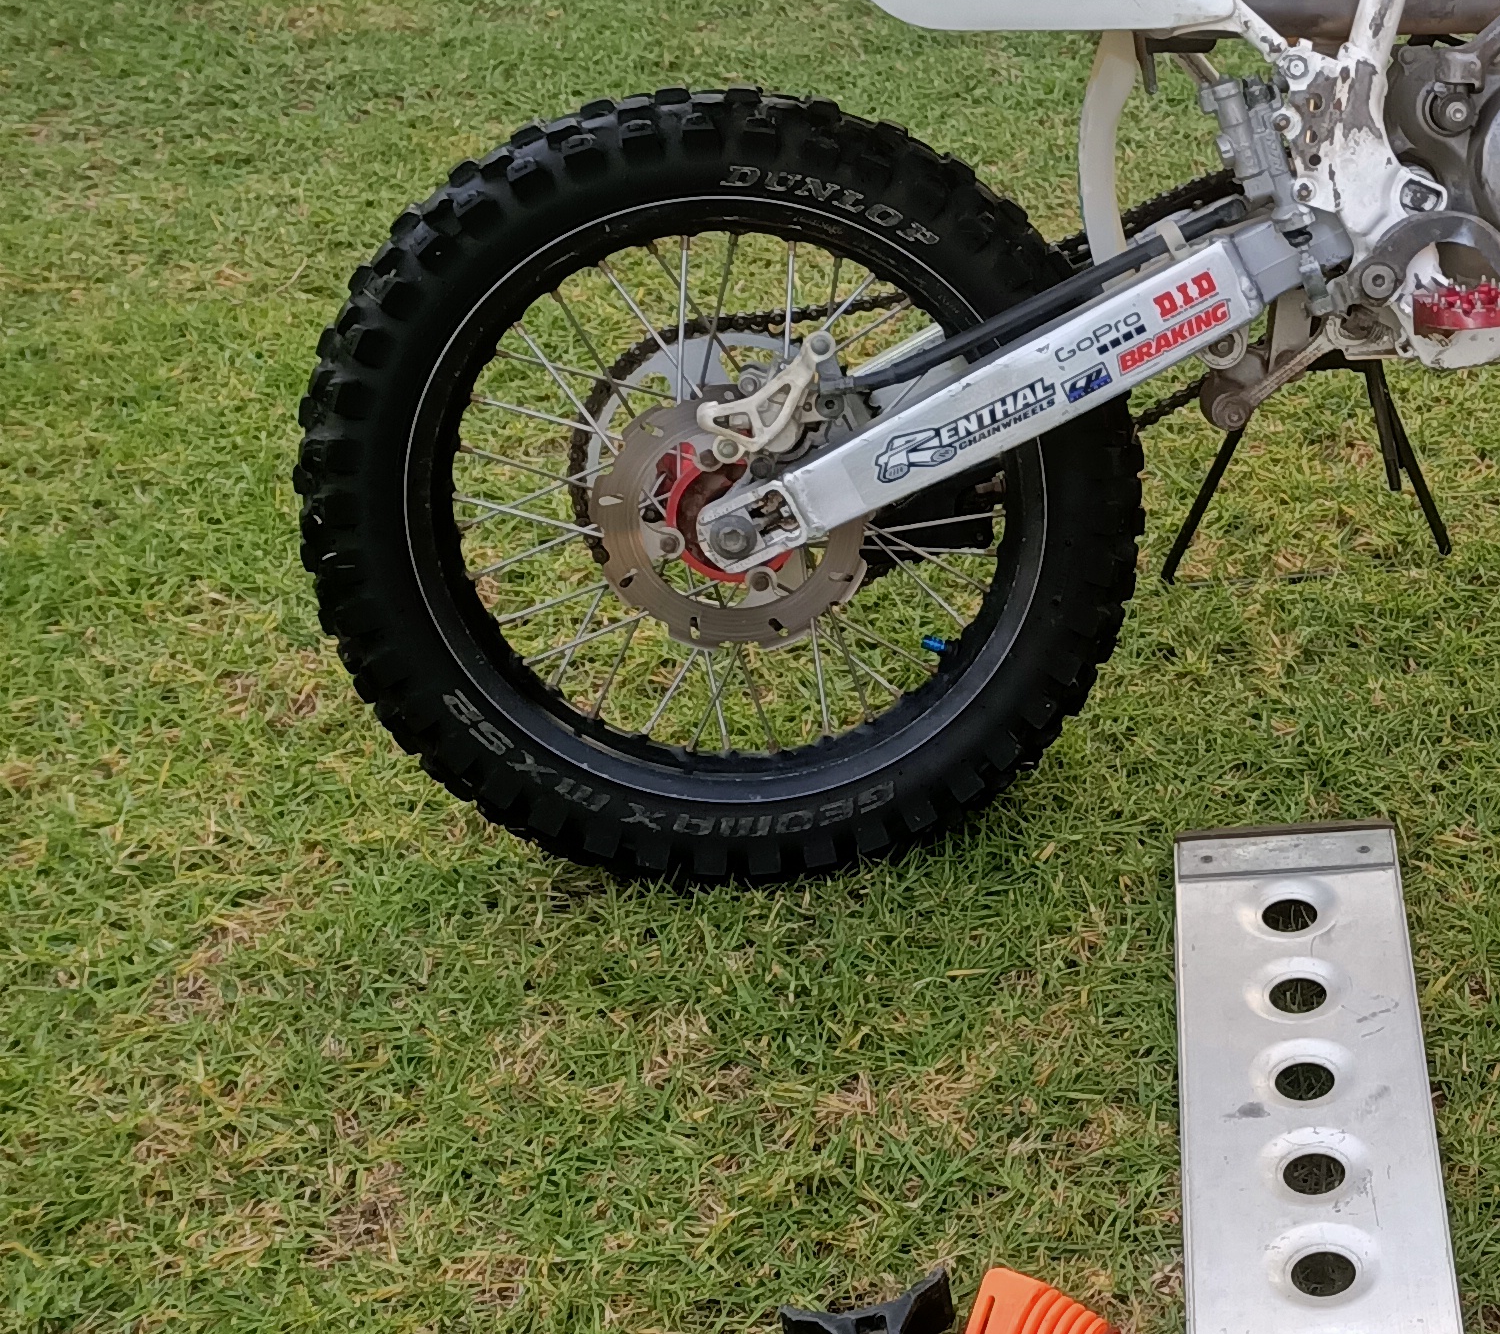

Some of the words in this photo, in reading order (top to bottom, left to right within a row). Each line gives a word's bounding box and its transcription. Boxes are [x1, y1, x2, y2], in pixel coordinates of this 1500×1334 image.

[719, 165, 941, 245] DUNLOP
[1054, 311, 1142, 363] GoPro
[1117, 299, 1230, 365] BRAKING
[875, 377, 1057, 484] RENTHAL
[957, 397, 1057, 451] CHAINWHEELS
[620, 780, 896, 838] GEOMAX
